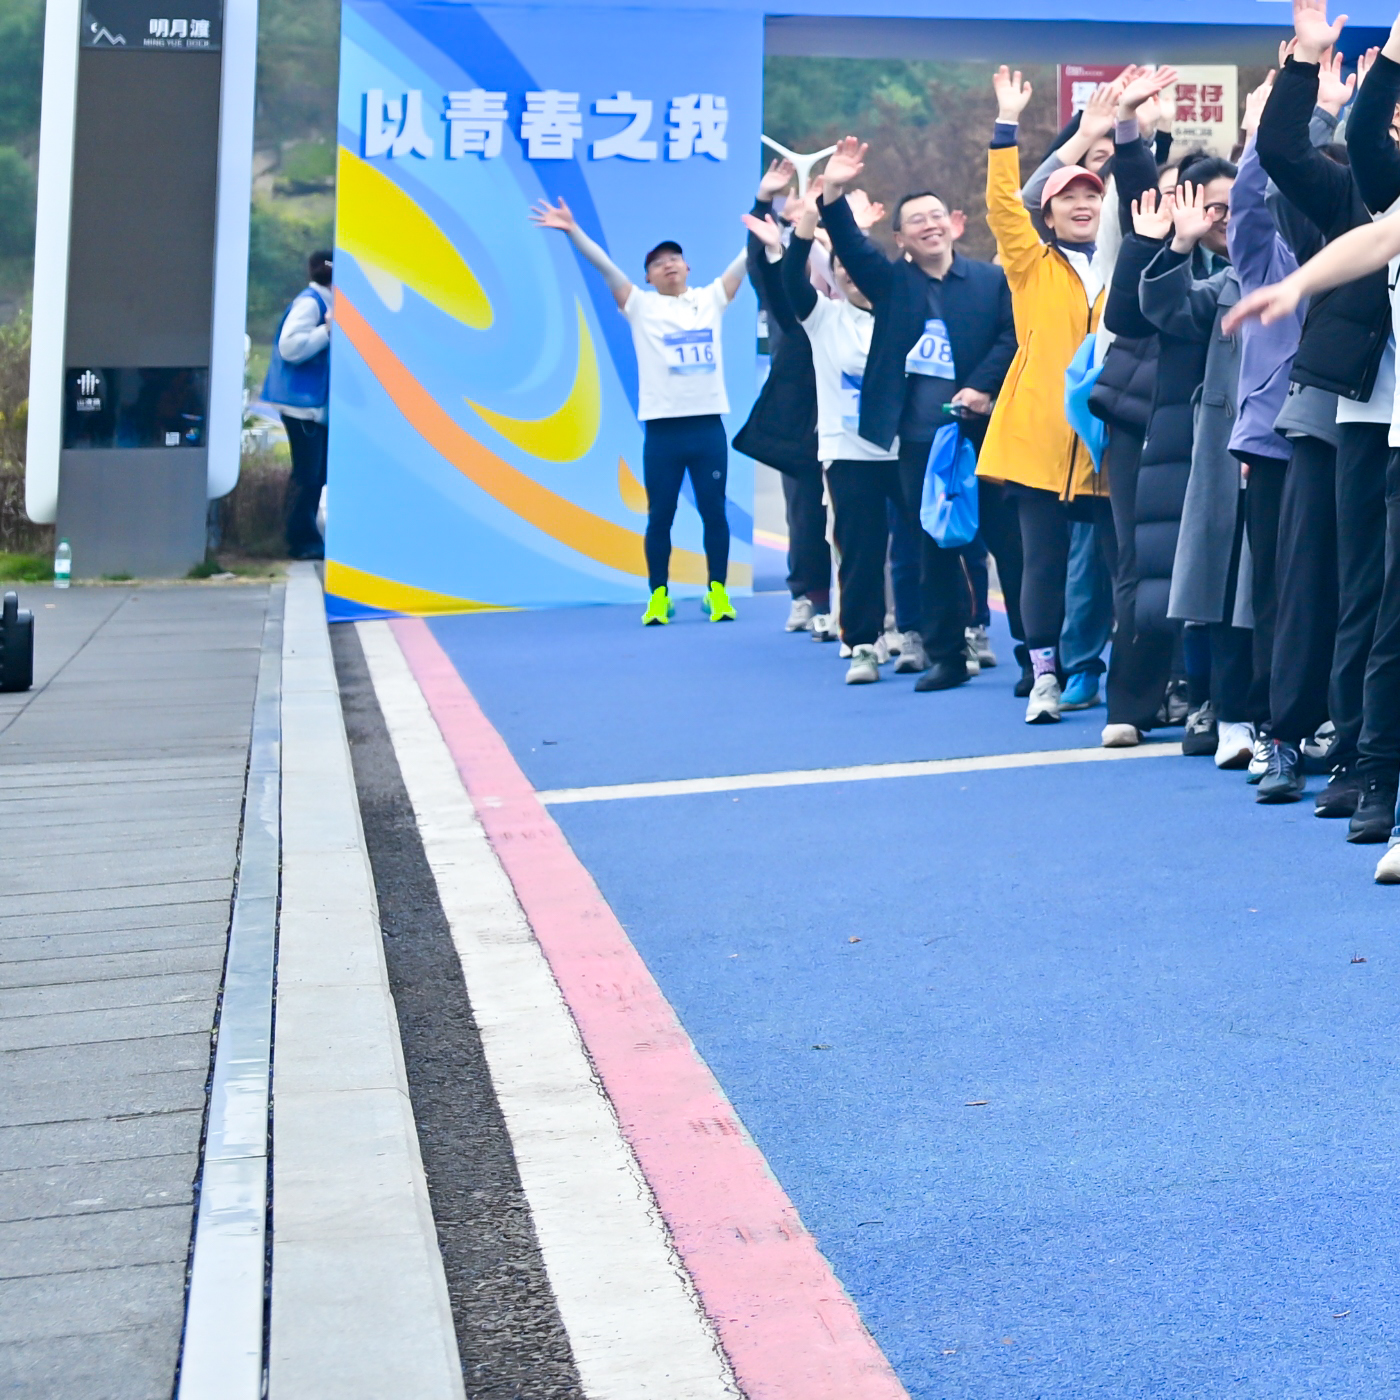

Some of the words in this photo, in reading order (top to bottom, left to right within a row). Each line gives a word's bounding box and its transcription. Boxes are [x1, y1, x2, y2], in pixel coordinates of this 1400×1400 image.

[149, 19, 210, 38] 明月渡
[366, 88, 729, 160] 以青春之我
[675, 344, 713, 363] 116
